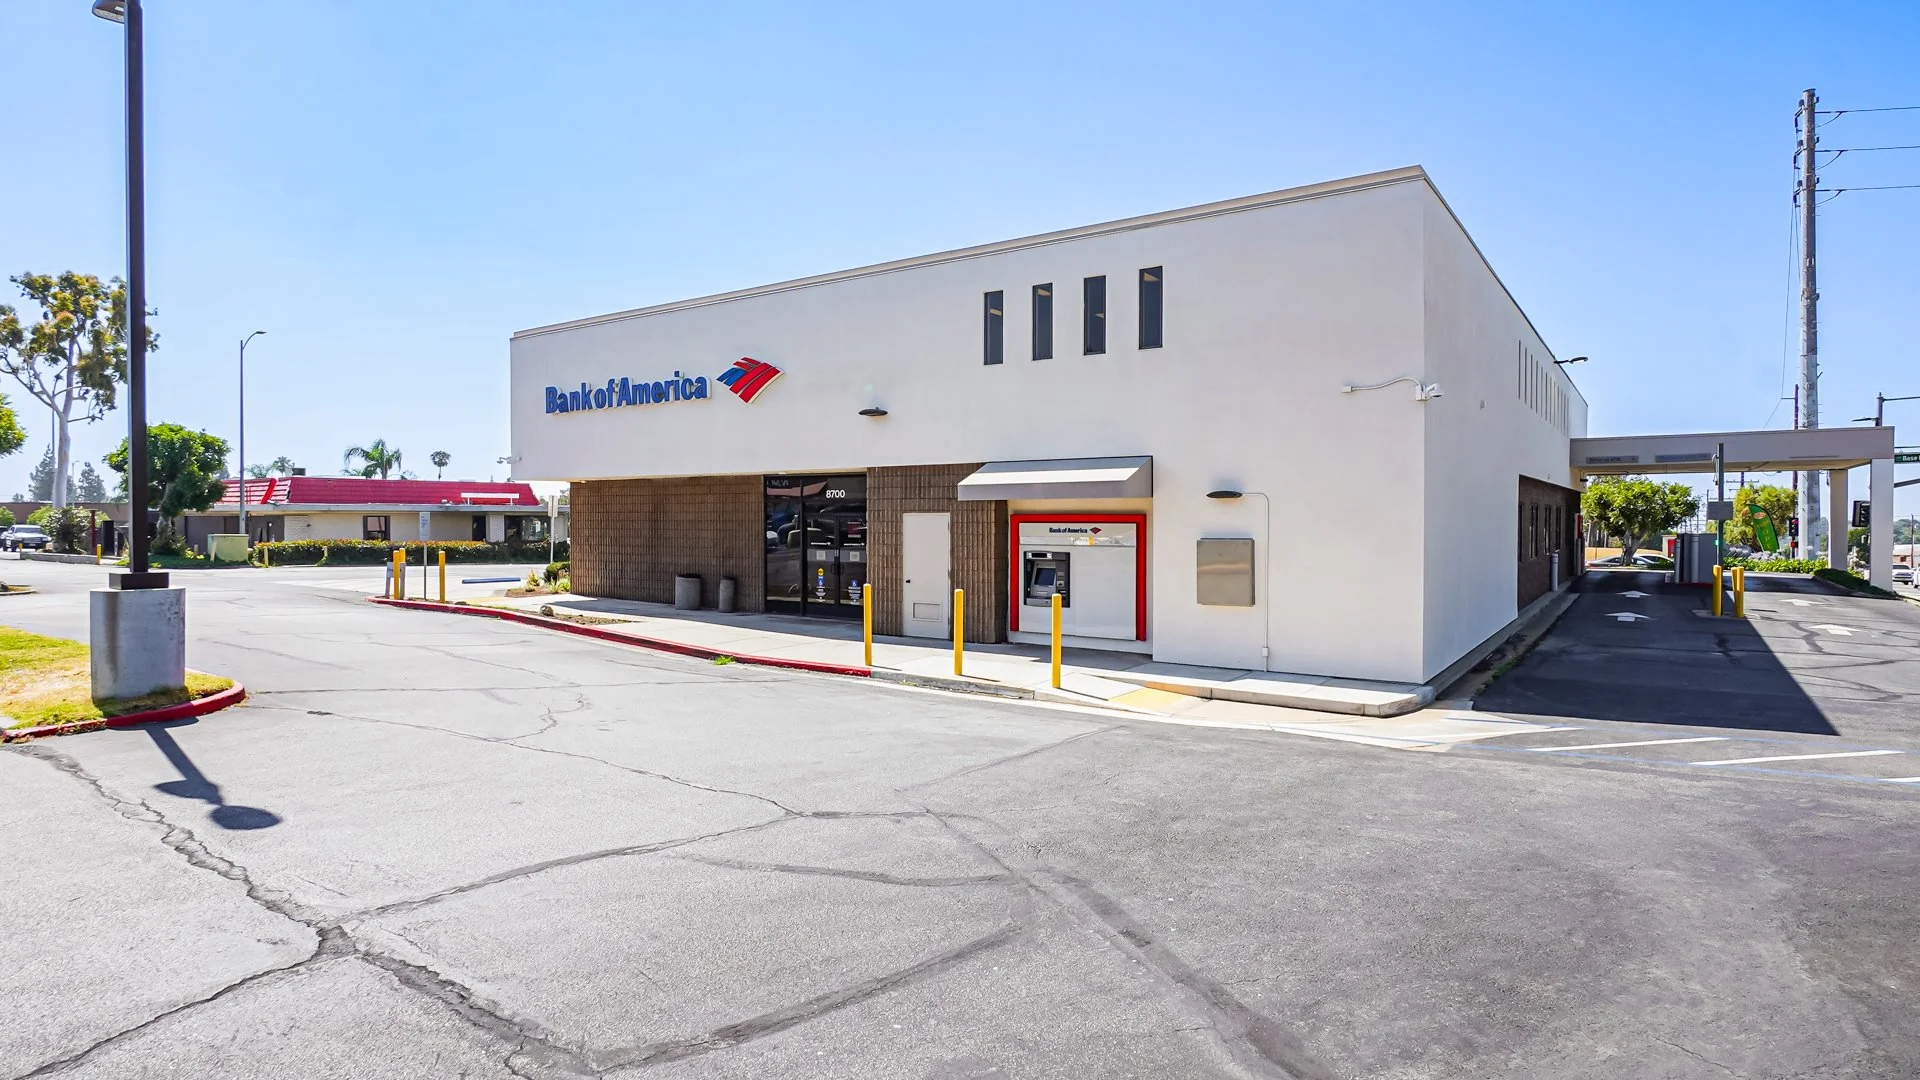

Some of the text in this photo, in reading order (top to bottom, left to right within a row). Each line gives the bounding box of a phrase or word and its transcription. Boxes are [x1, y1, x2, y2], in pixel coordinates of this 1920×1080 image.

[545, 371, 711, 414] Bank of America
[825, 489, 846, 499] 8700
